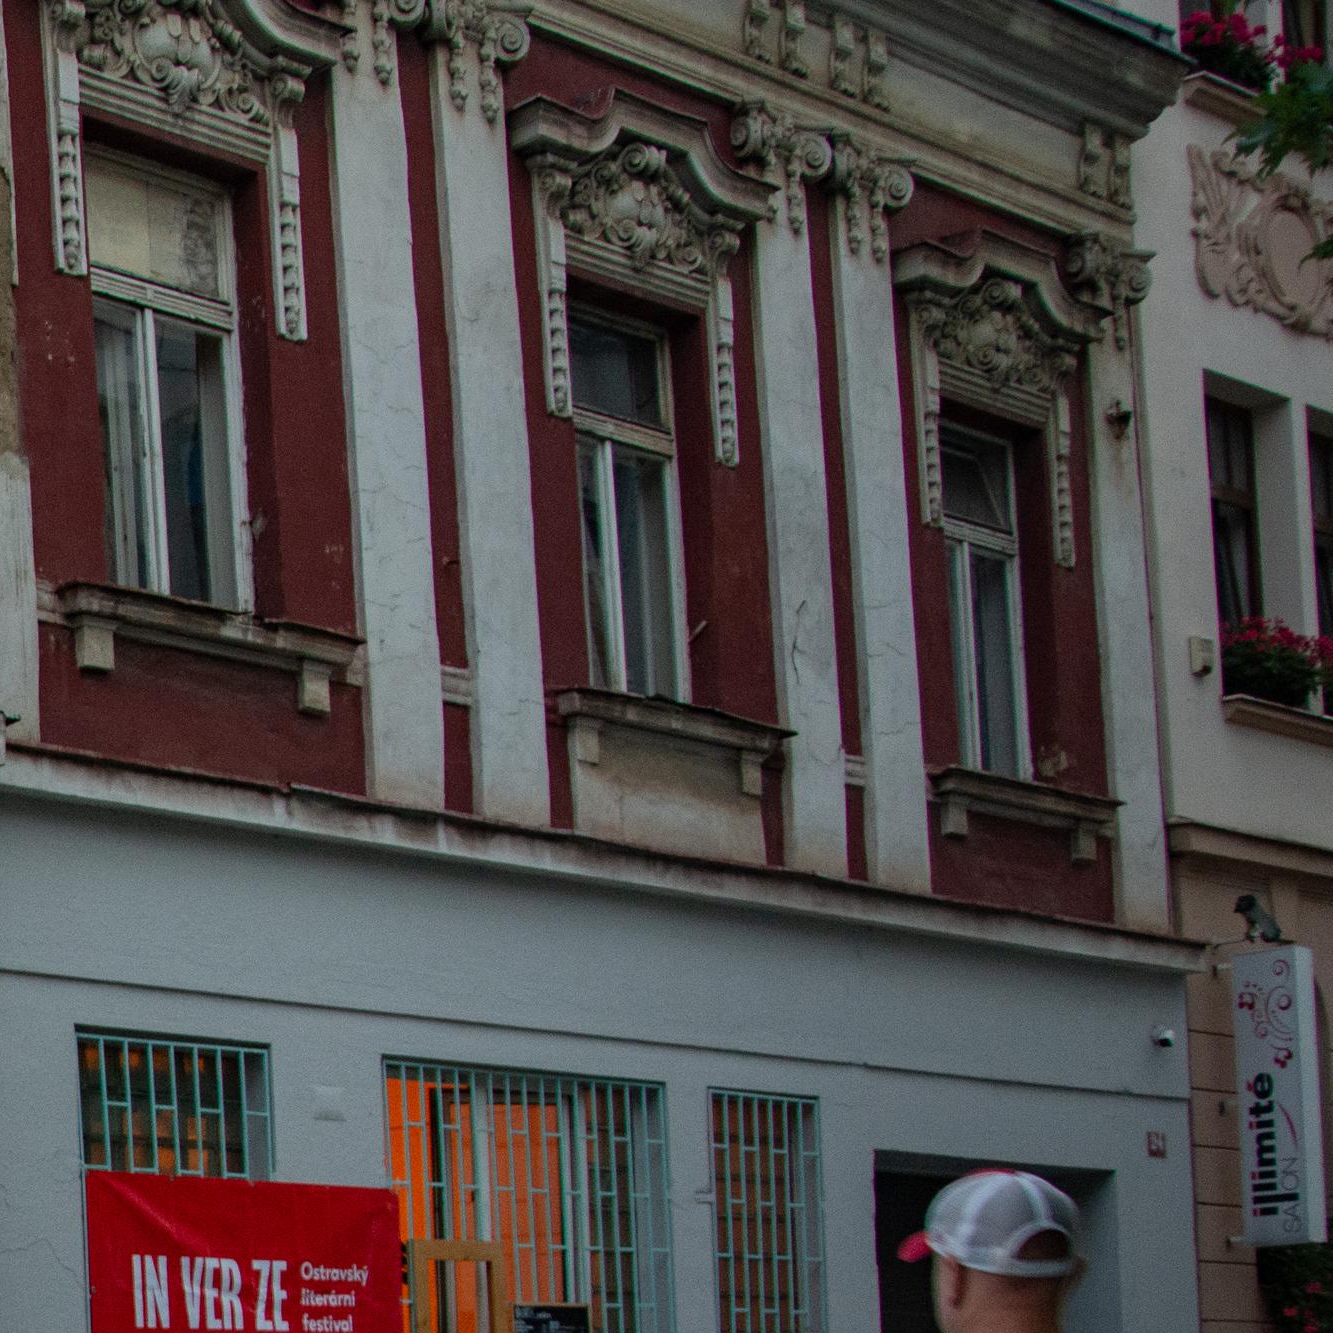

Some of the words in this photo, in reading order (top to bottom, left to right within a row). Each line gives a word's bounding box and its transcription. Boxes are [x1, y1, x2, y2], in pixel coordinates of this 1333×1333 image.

[1246, 1072, 1289, 1216] illimité
[300, 1261, 369, 1287] Ostravský
[132, 1254, 170, 1329] IN
[181, 1257, 244, 1330] VER
[252, 1260, 290, 1332] ZE
[300, 1288, 356, 1307] literární
[302, 1313, 354, 1333] festival
